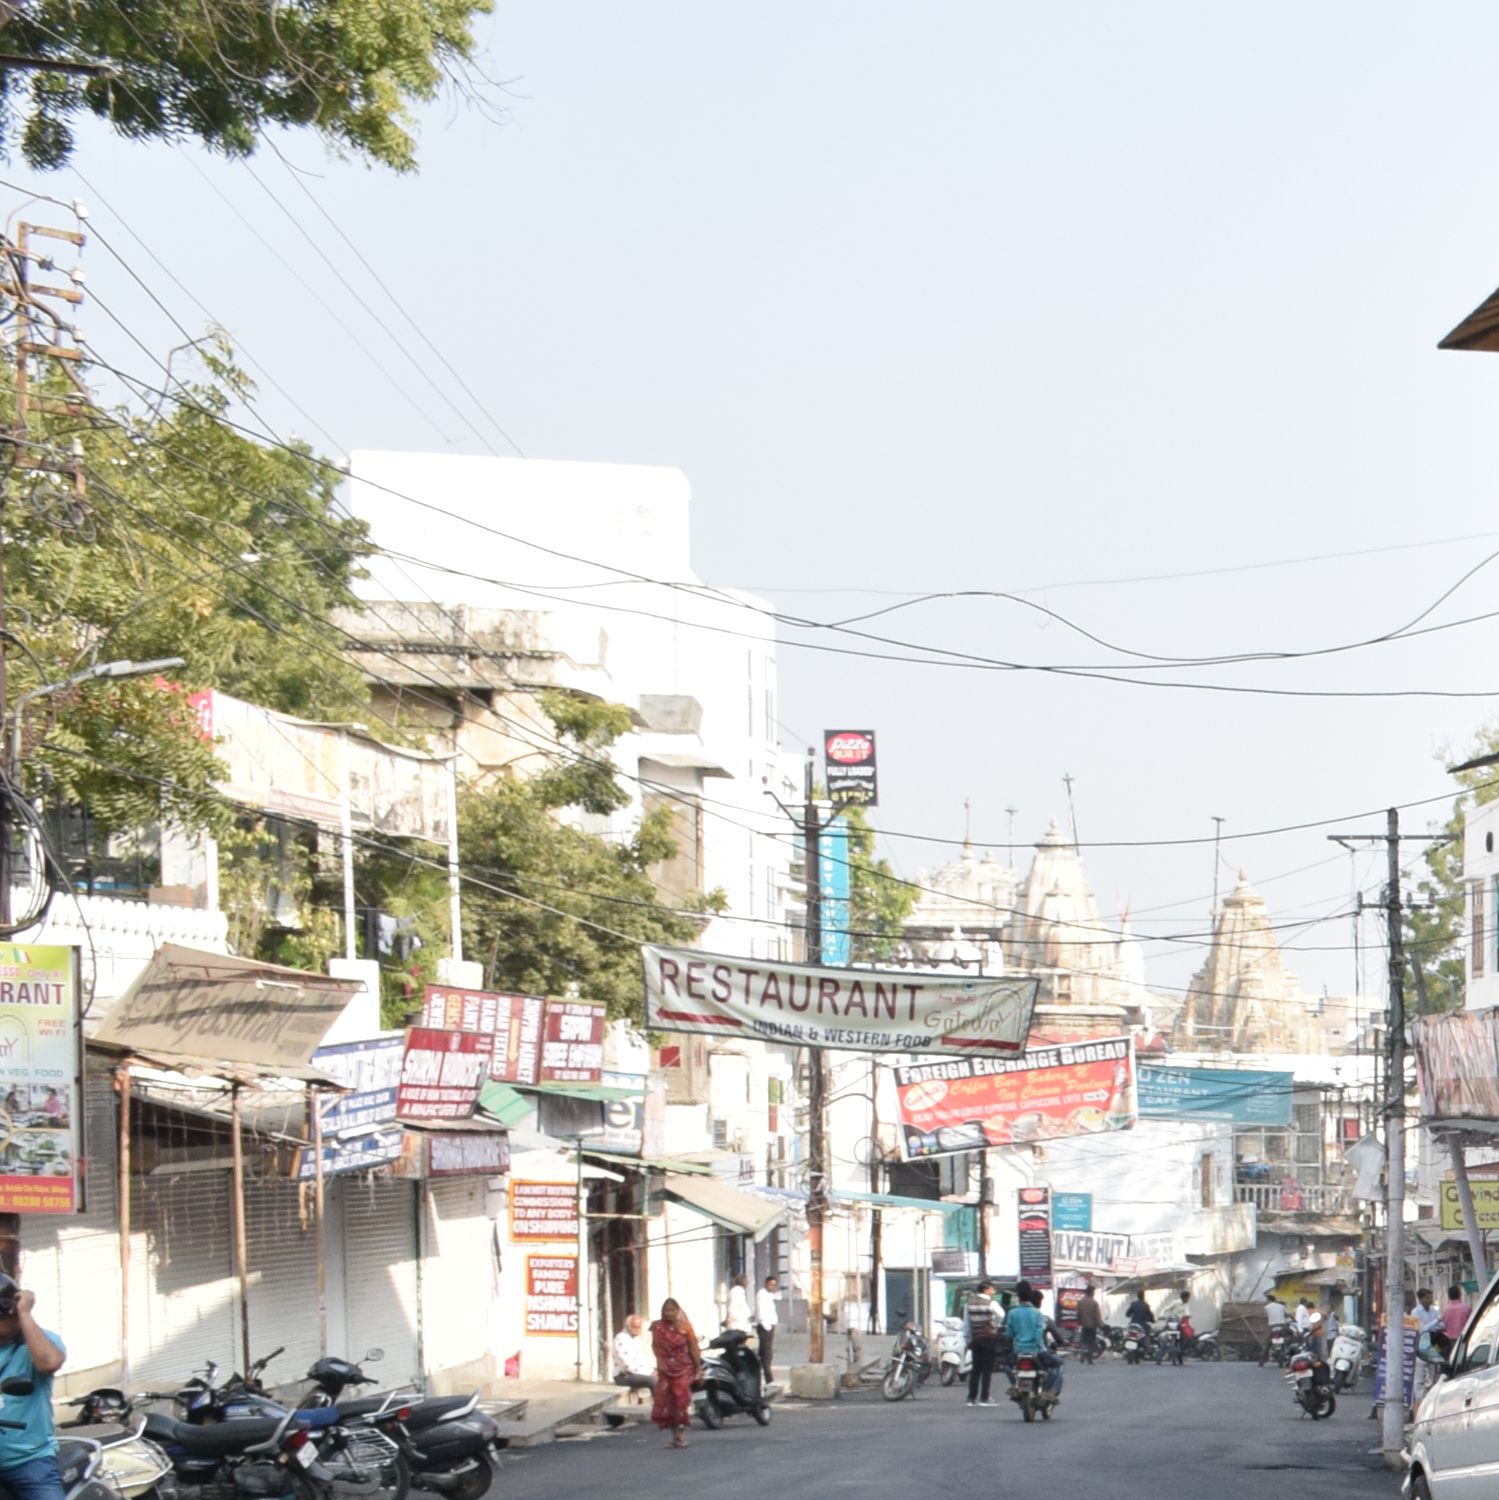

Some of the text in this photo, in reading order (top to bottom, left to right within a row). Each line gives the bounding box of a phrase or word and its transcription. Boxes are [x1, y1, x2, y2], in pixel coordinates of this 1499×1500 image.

[658, 957, 924, 1021] RESTAURANT
[752, 1018, 803, 1039] INDIAN
[824, 1027, 892, 1046] WESTERN
[901, 1060, 970, 1085] FOREIGN
[973, 1052, 1058, 1075] EXCHANGE
[1060, 1042, 1127, 1065] BUREAU
[534, 1281, 566, 1294] PURE
[527, 1314, 578, 1330] SHAWLS
